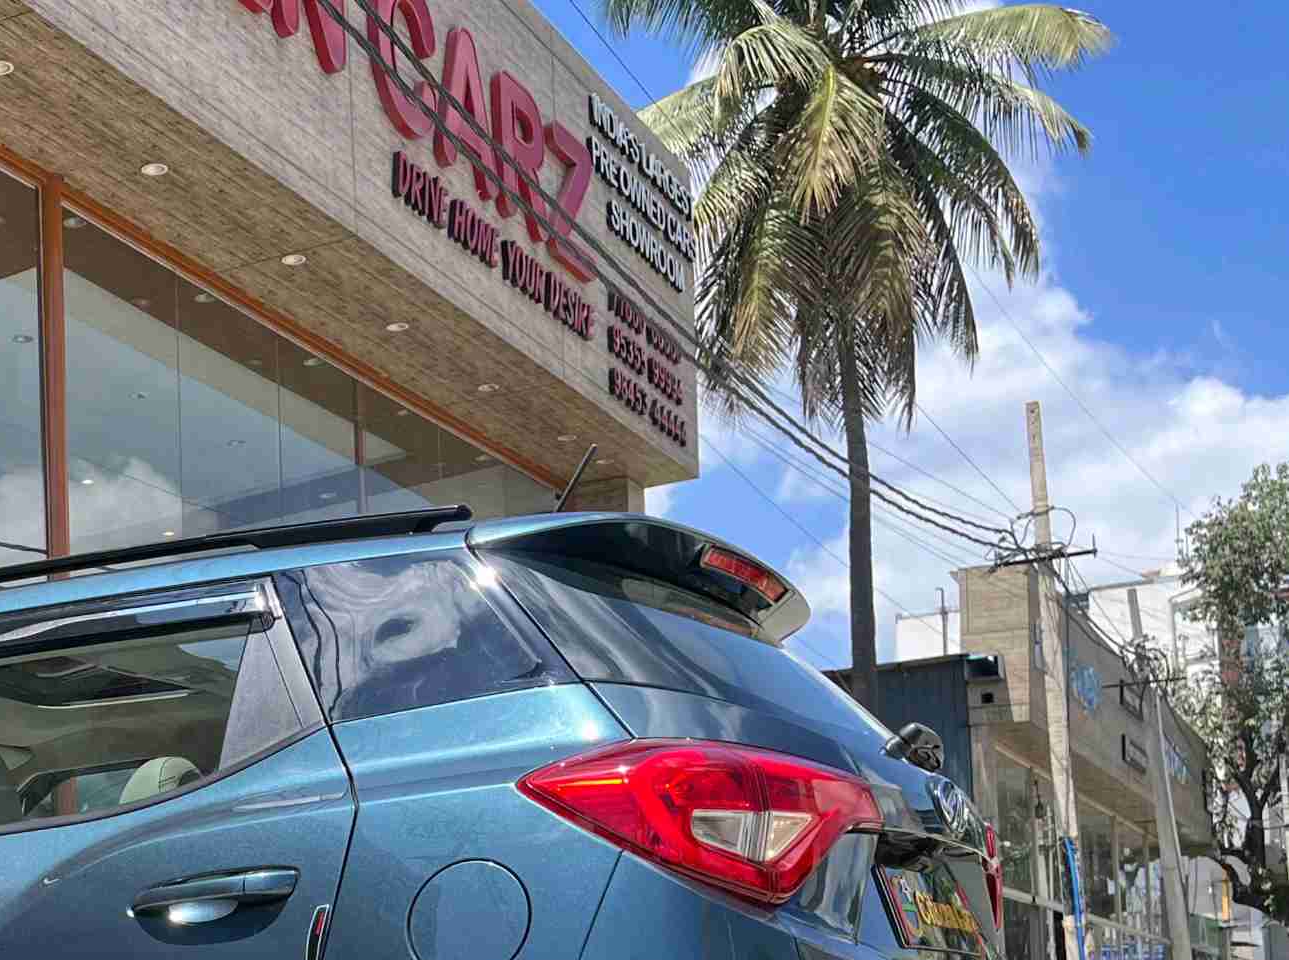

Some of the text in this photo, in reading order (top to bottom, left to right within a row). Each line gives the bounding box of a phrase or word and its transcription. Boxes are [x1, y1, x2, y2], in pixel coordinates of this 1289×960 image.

[638, 142, 695, 222] LARGEST
[392, 150, 449, 229] DRIVE
[447, 198, 500, 268] HOME
[500, 239, 545, 304] YOUR
[543, 270, 596, 341] DESIRE
[608, 200, 686, 293] SHOWROOM
[666, 213, 696, 263] CARS
